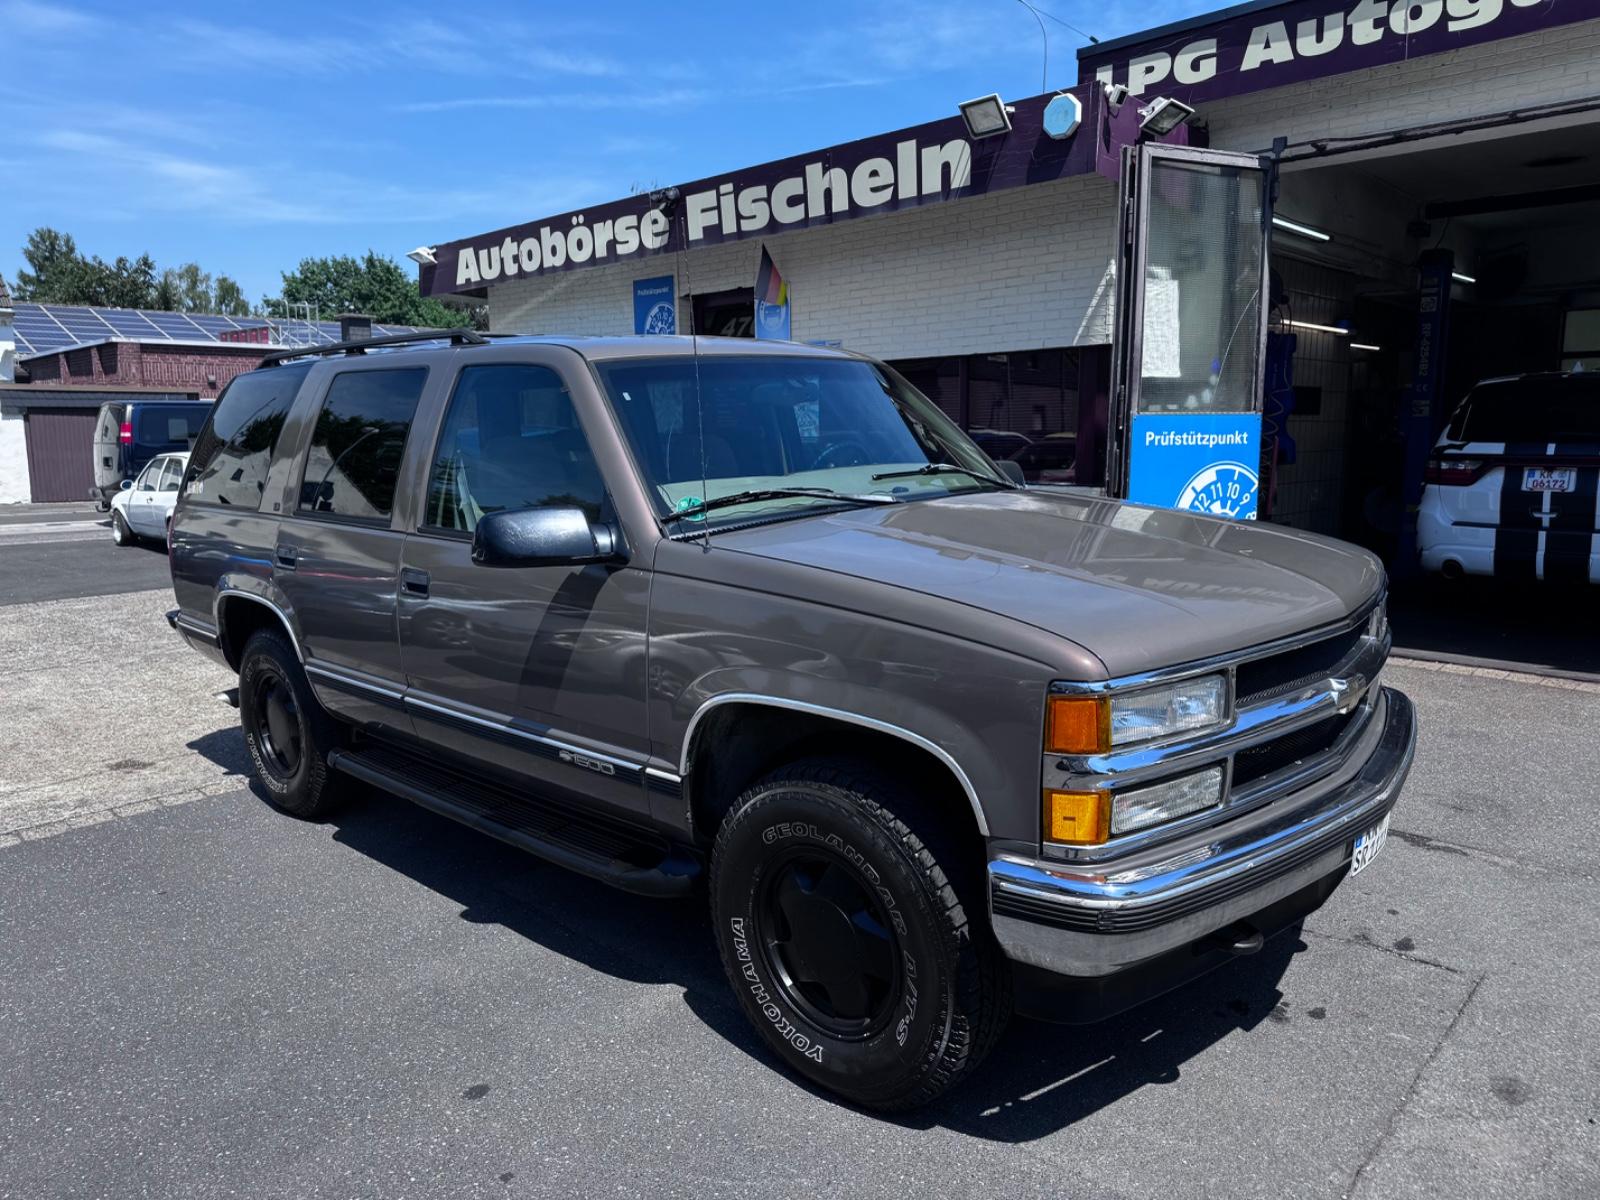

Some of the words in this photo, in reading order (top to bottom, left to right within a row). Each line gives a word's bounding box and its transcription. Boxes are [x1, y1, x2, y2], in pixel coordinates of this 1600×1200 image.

[1240, 0, 1544, 72] Autog
[456, 208, 670, 286] Autobörse
[686, 139, 971, 241] Fischeln
[1145, 430, 1248, 448] Prüfstützpunkt
[1210, 482, 1223, 500] 11
[1226, 481, 1240, 499] 10
[1239, 493, 1251, 505] 9
[762, 822, 907, 937] GEOLANDAR
[731, 917, 823, 1063] YOKOHAMA
